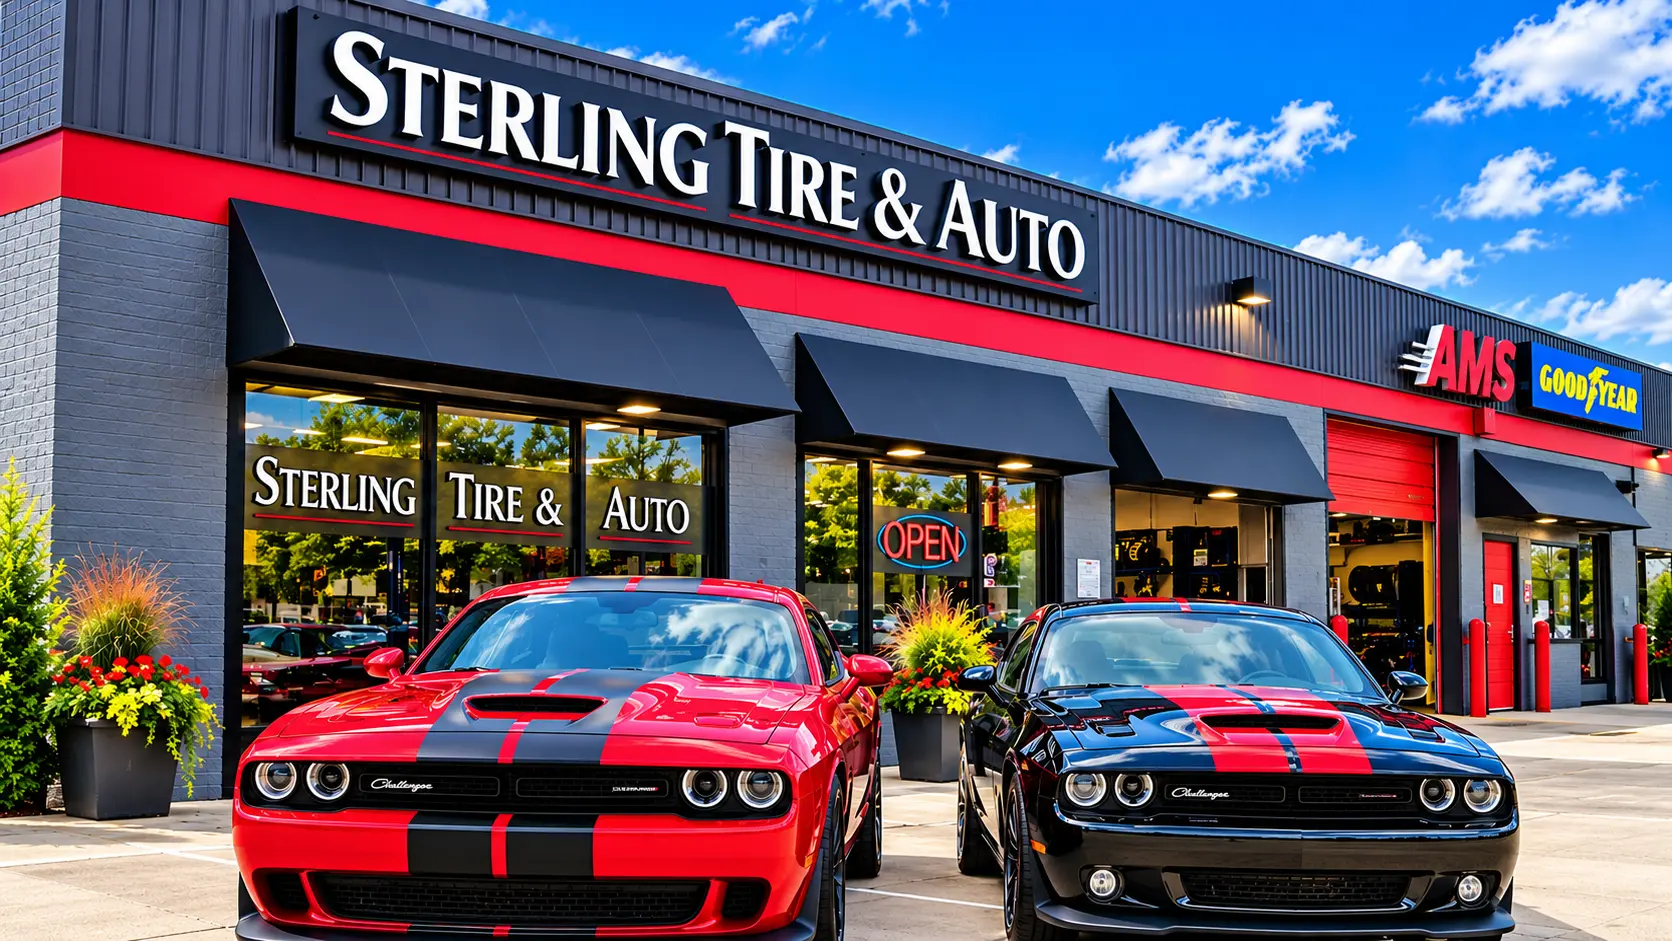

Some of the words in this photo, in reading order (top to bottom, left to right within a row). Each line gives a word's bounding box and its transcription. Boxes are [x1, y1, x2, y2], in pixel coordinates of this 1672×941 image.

[329, 30, 710, 196] STERLING
[724, 119, 861, 231] TIRE
[873, 167, 928, 246] &
[935, 178, 1086, 281] AUTO
[1415, 324, 1518, 403] AMS
[1540, 364, 1638, 414] GOODYEAR
[254, 455, 417, 516] STERLING
[447, 472, 525, 524] TIRE
[535, 487, 565, 527] &
[602, 485, 691, 535] AUTO
[883, 520, 960, 563] OPEN
